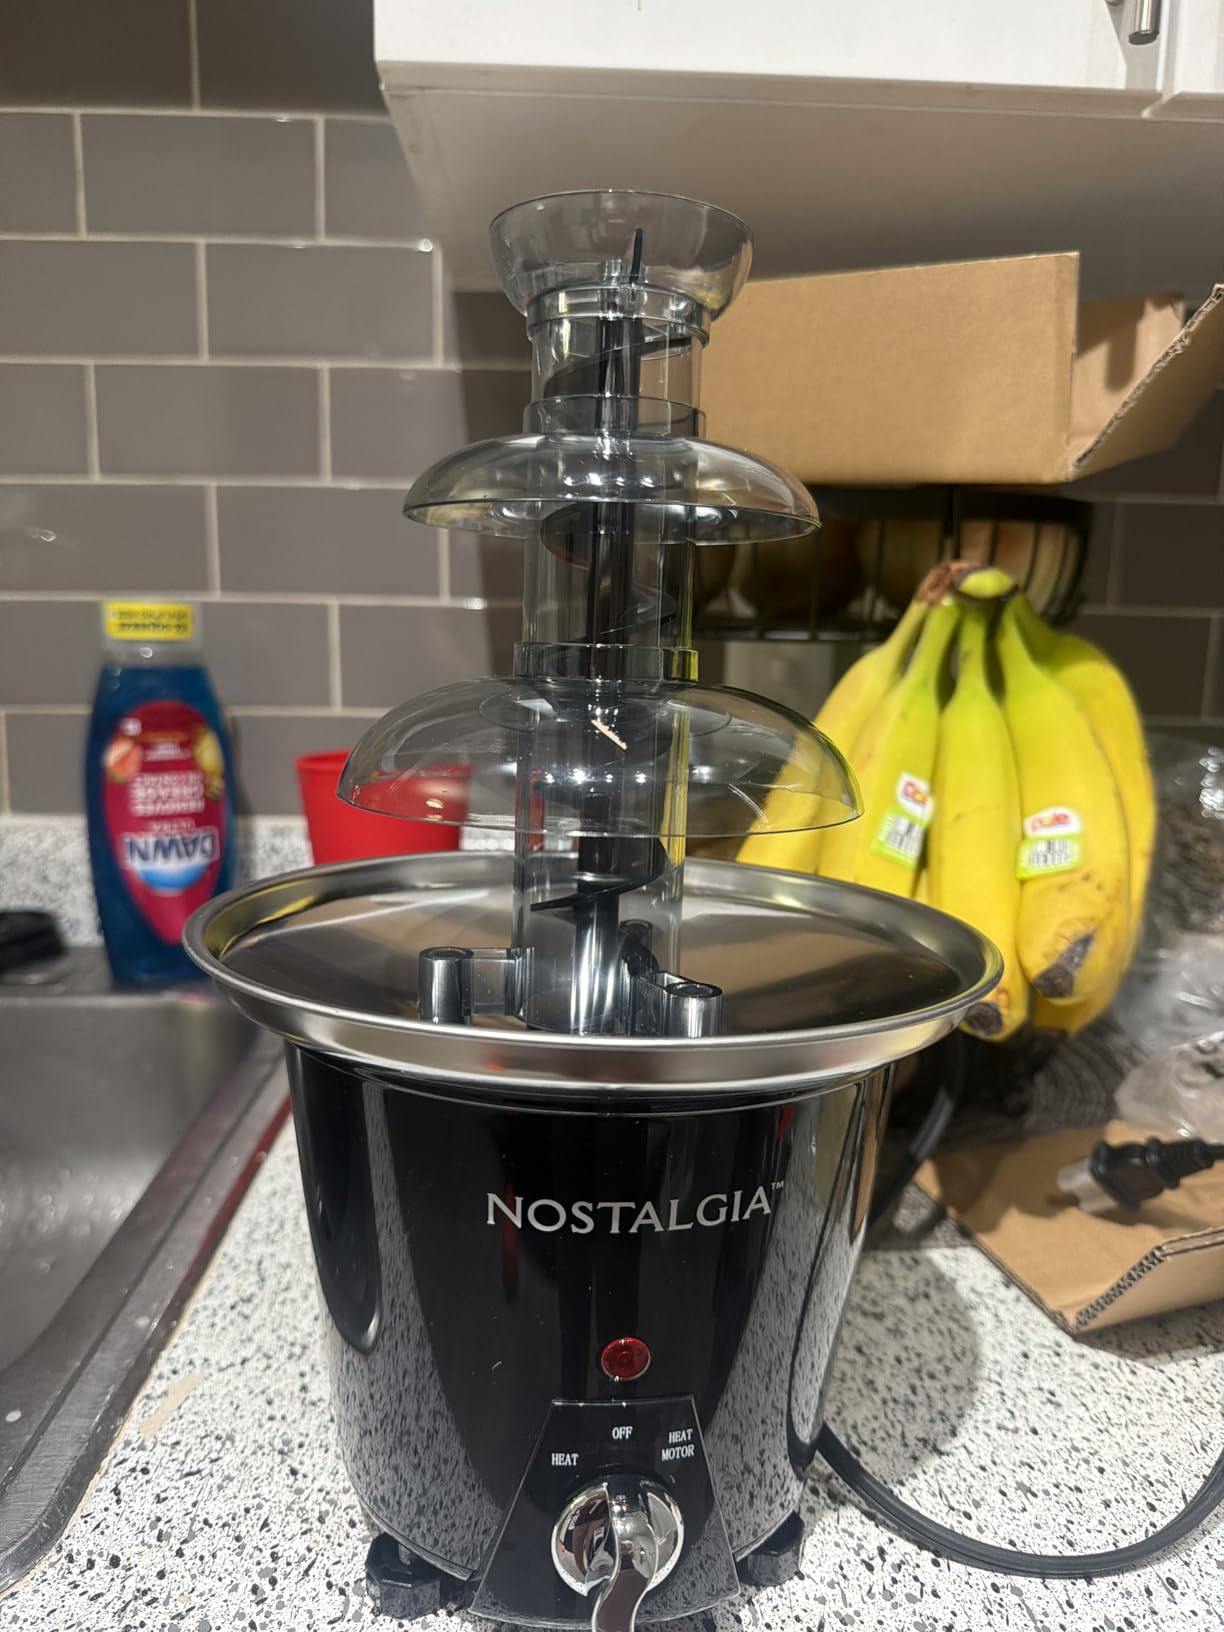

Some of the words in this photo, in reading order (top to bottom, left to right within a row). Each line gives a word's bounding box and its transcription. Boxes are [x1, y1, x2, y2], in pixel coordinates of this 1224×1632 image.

[128, 830, 217, 863] DAWN
[612, 1426, 633, 1440] OFF
[668, 1429, 694, 1444] HEAT
[551, 1453, 579, 1466] HEAT
[661, 1444, 695, 1461] MOTOR
